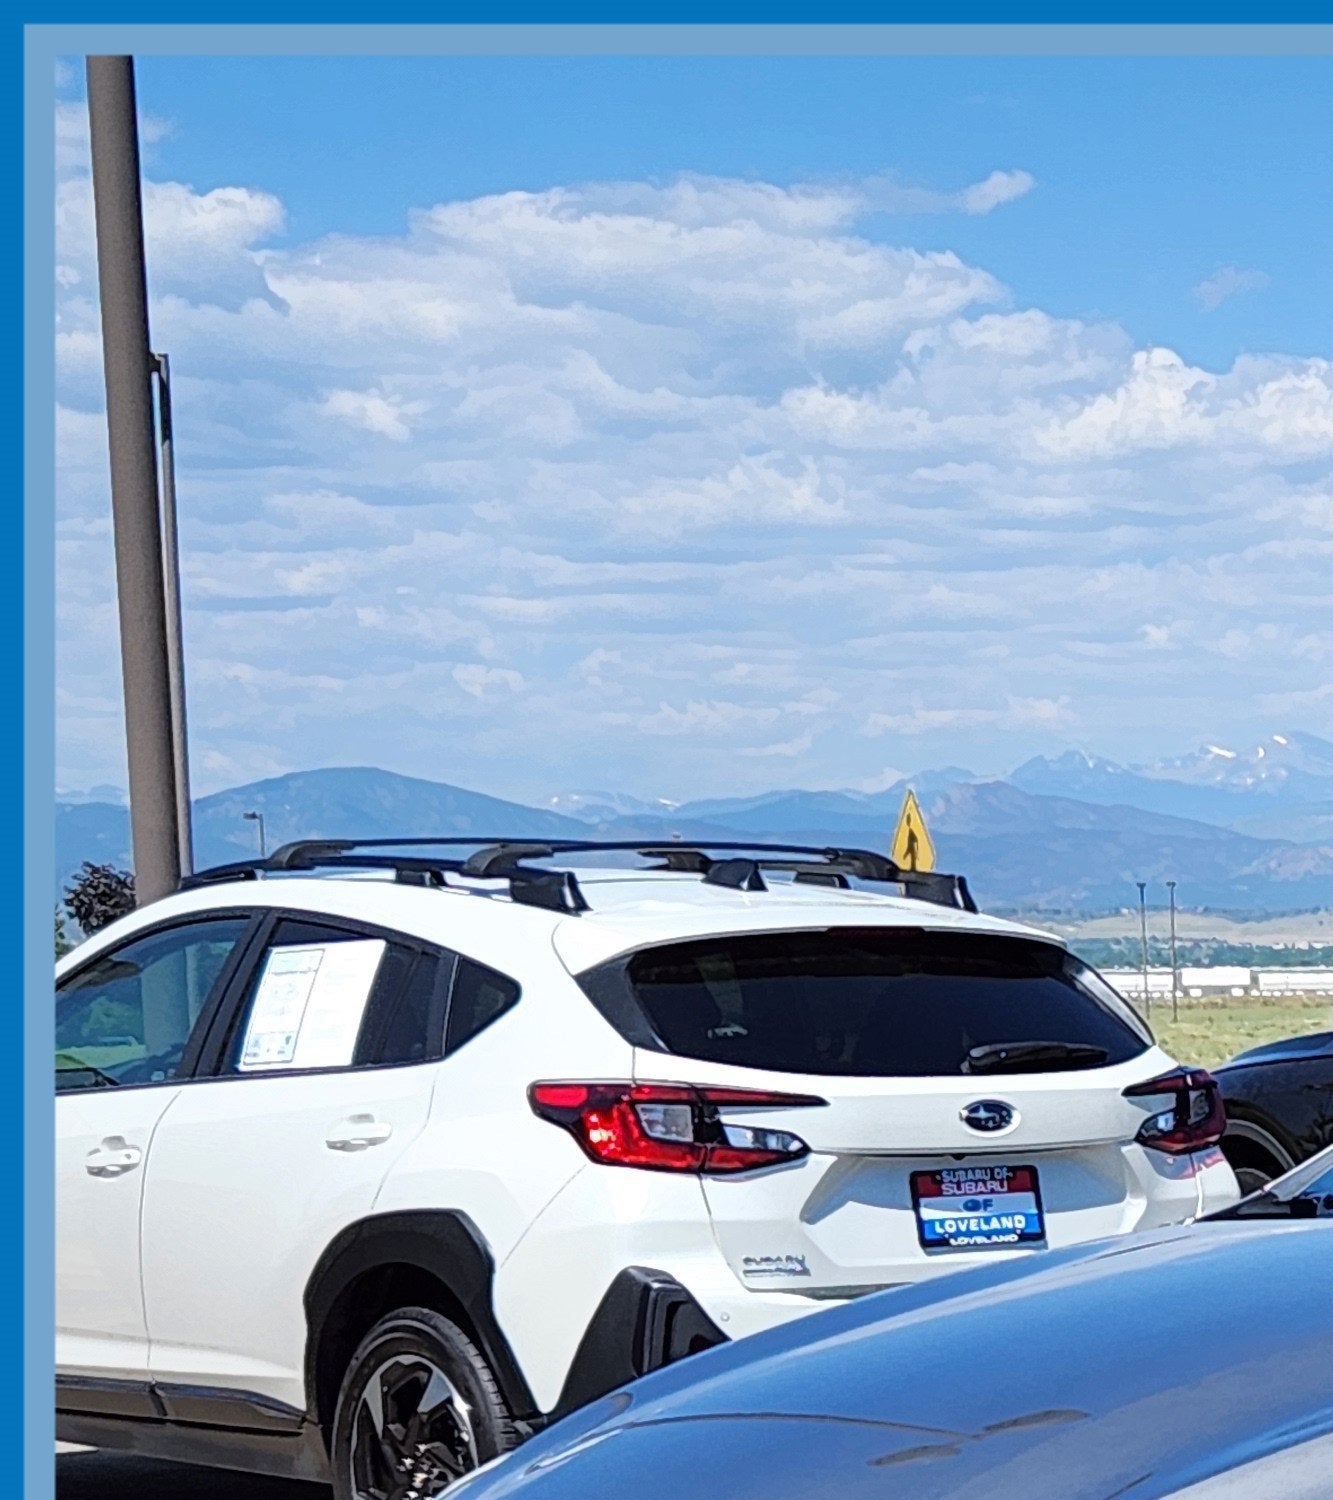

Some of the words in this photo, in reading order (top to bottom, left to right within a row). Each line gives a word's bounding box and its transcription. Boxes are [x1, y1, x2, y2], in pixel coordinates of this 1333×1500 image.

[941, 1168, 990, 1183] SUBARU
[941, 1180, 1008, 1195] SUBARU
[934, 1214, 1026, 1235] LOVELAND
